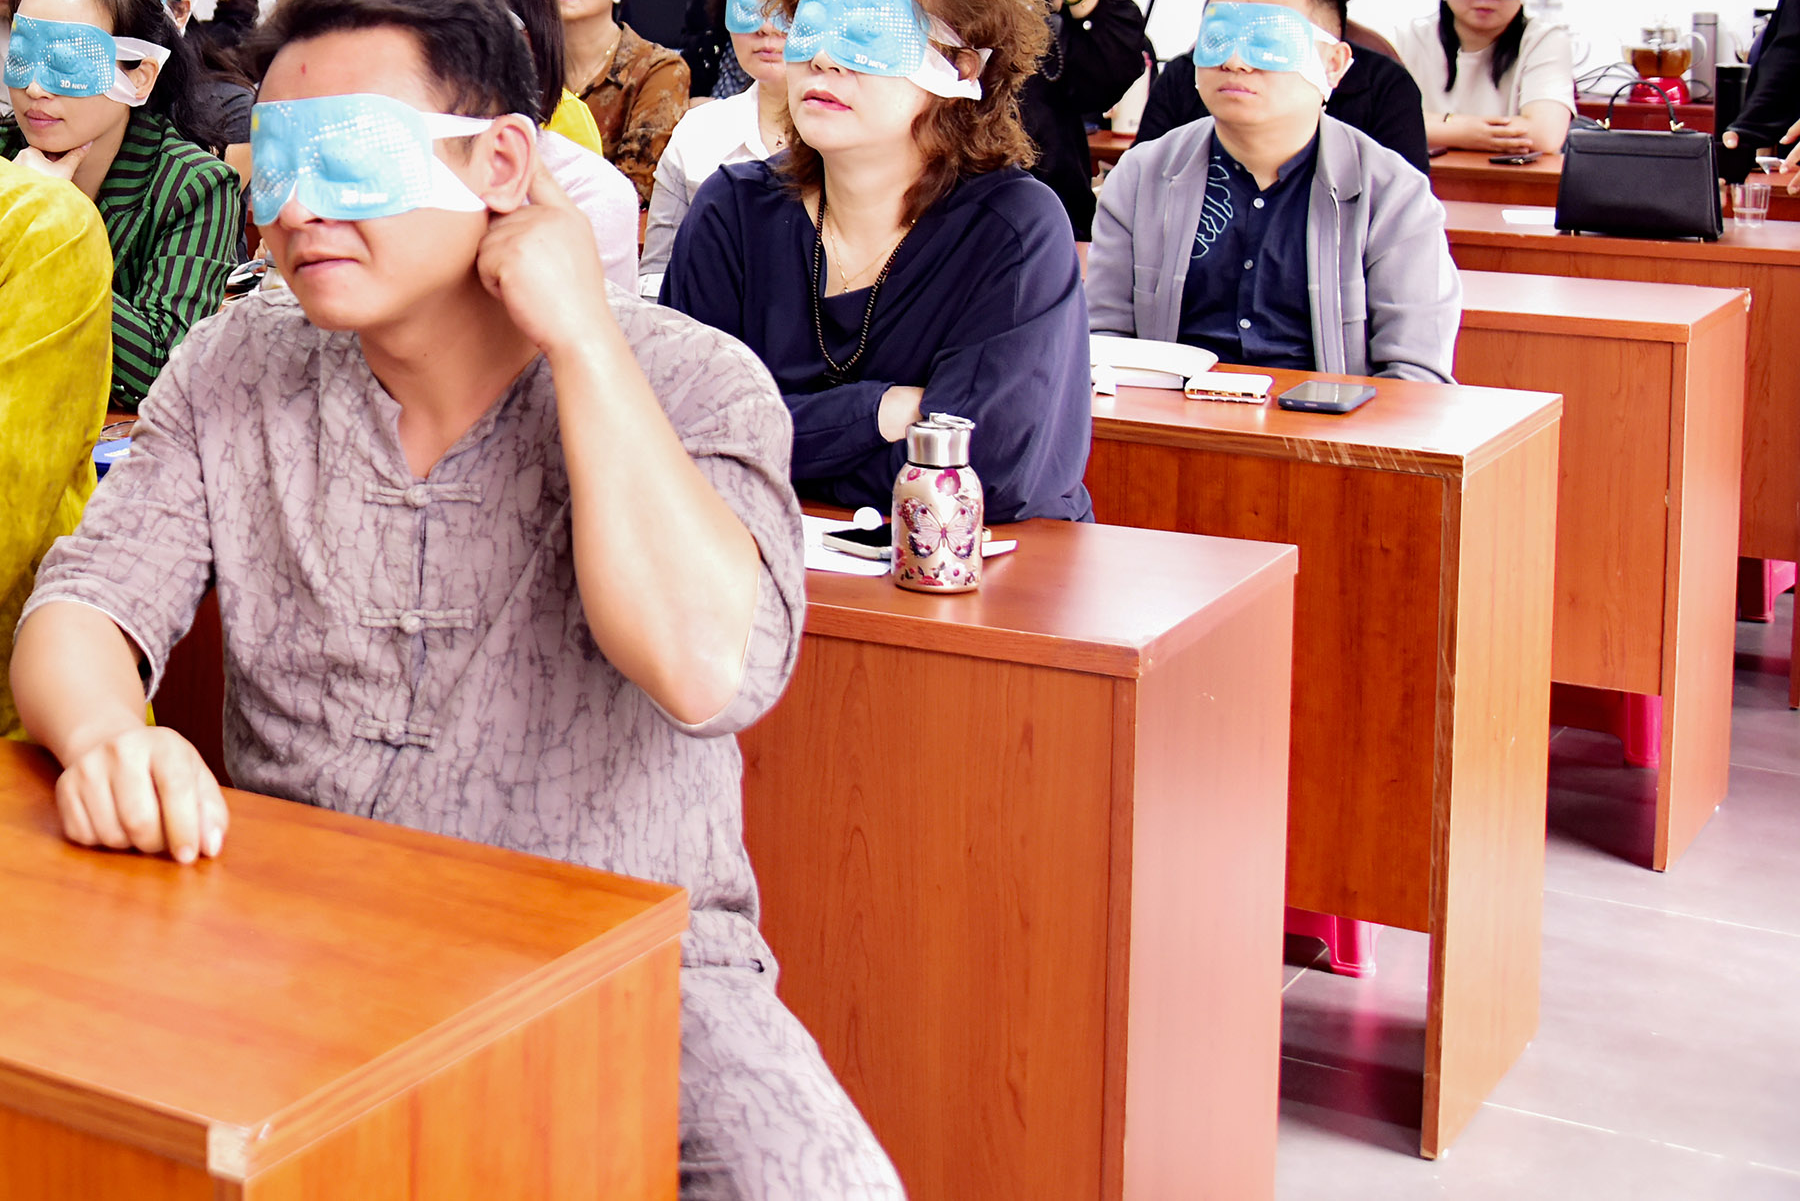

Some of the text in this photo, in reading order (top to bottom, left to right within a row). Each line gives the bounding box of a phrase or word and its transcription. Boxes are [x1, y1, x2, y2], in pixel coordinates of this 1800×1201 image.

[854, 53, 868, 65] 3D
[60, 79, 88, 91] 3D NEW
